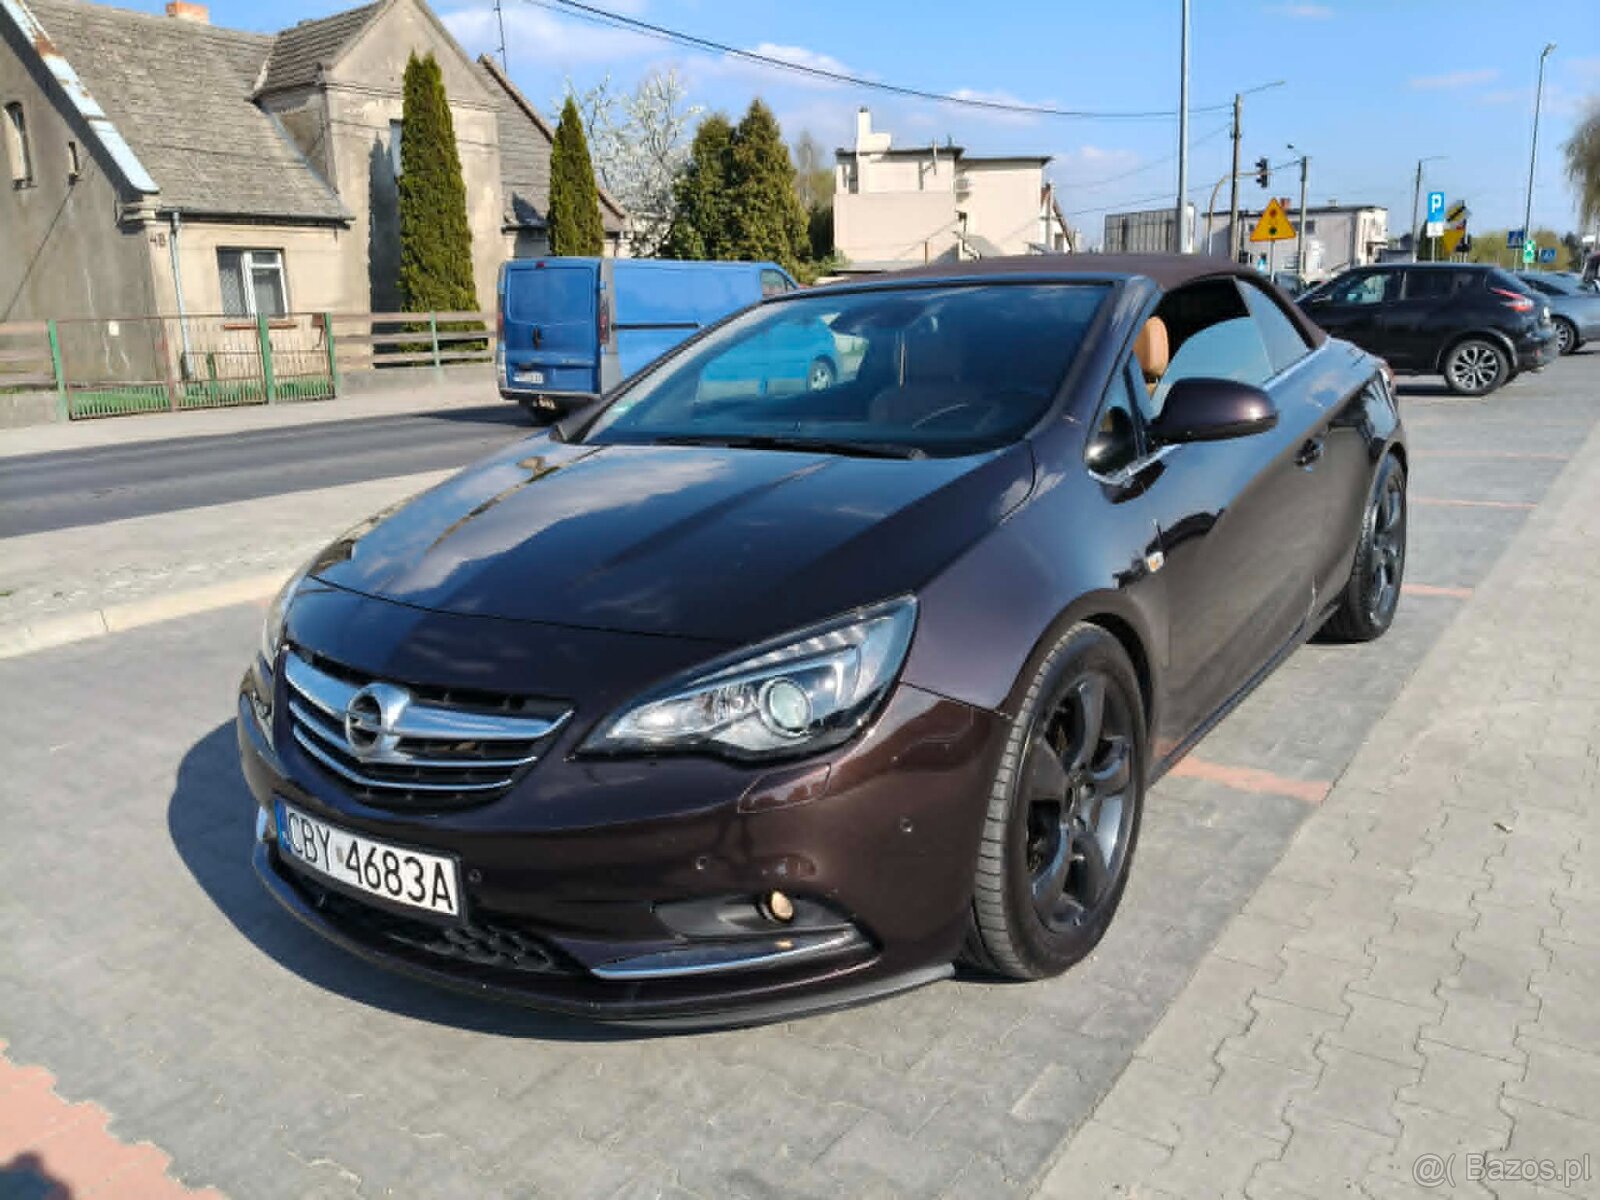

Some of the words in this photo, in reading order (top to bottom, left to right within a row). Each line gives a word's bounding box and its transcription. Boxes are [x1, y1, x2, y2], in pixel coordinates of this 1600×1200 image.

[1431, 194, 1442, 213] P
[288, 812, 331, 871] CBY
[345, 841, 453, 910] 4683A
